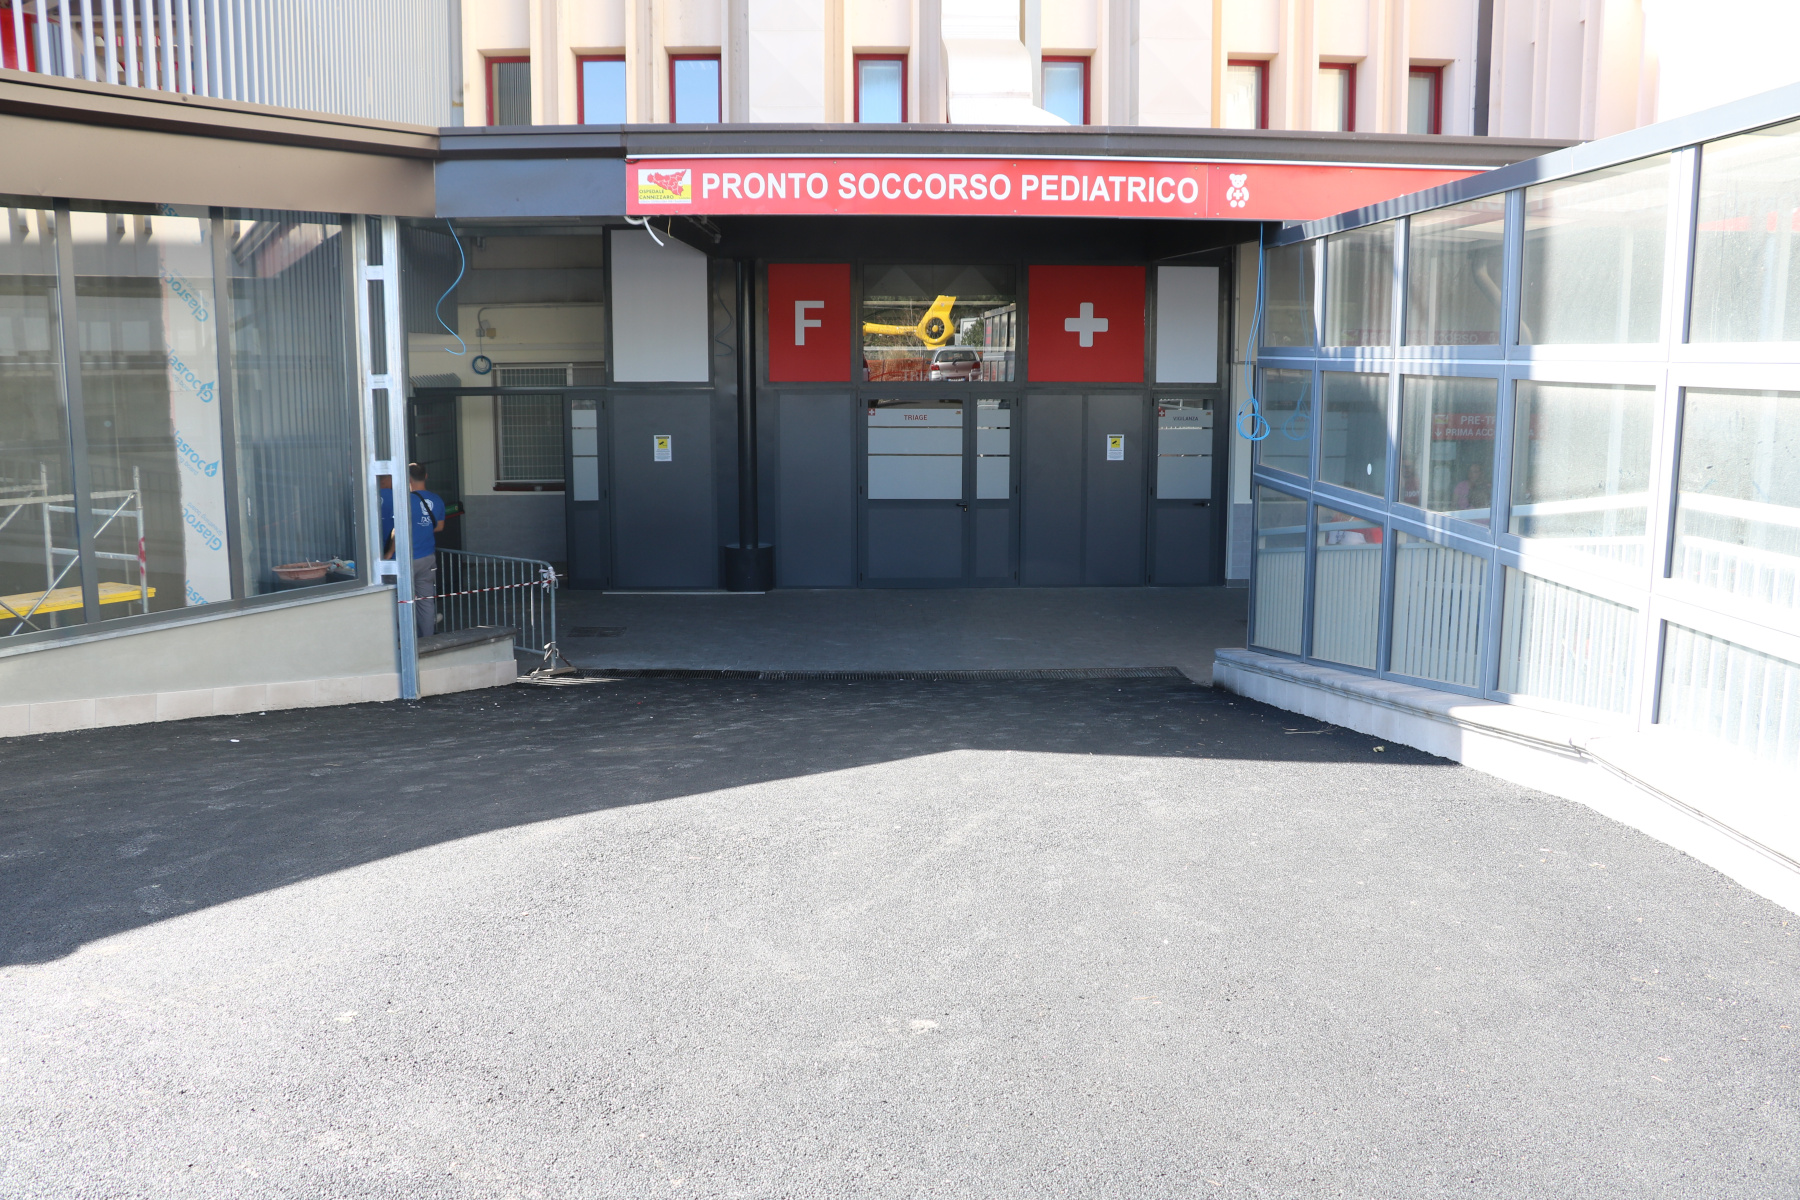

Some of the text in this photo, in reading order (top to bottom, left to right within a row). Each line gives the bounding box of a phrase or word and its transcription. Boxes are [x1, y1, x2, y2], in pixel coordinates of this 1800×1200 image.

[702, 172, 1199, 204] PRONTO SOCCORSO PEDIATRICO
[164, 273, 209, 322] Glasroc
[794, 300, 825, 346] F
[174, 430, 206, 471] lasroc
[1445, 428, 1474, 437] PRIMA
